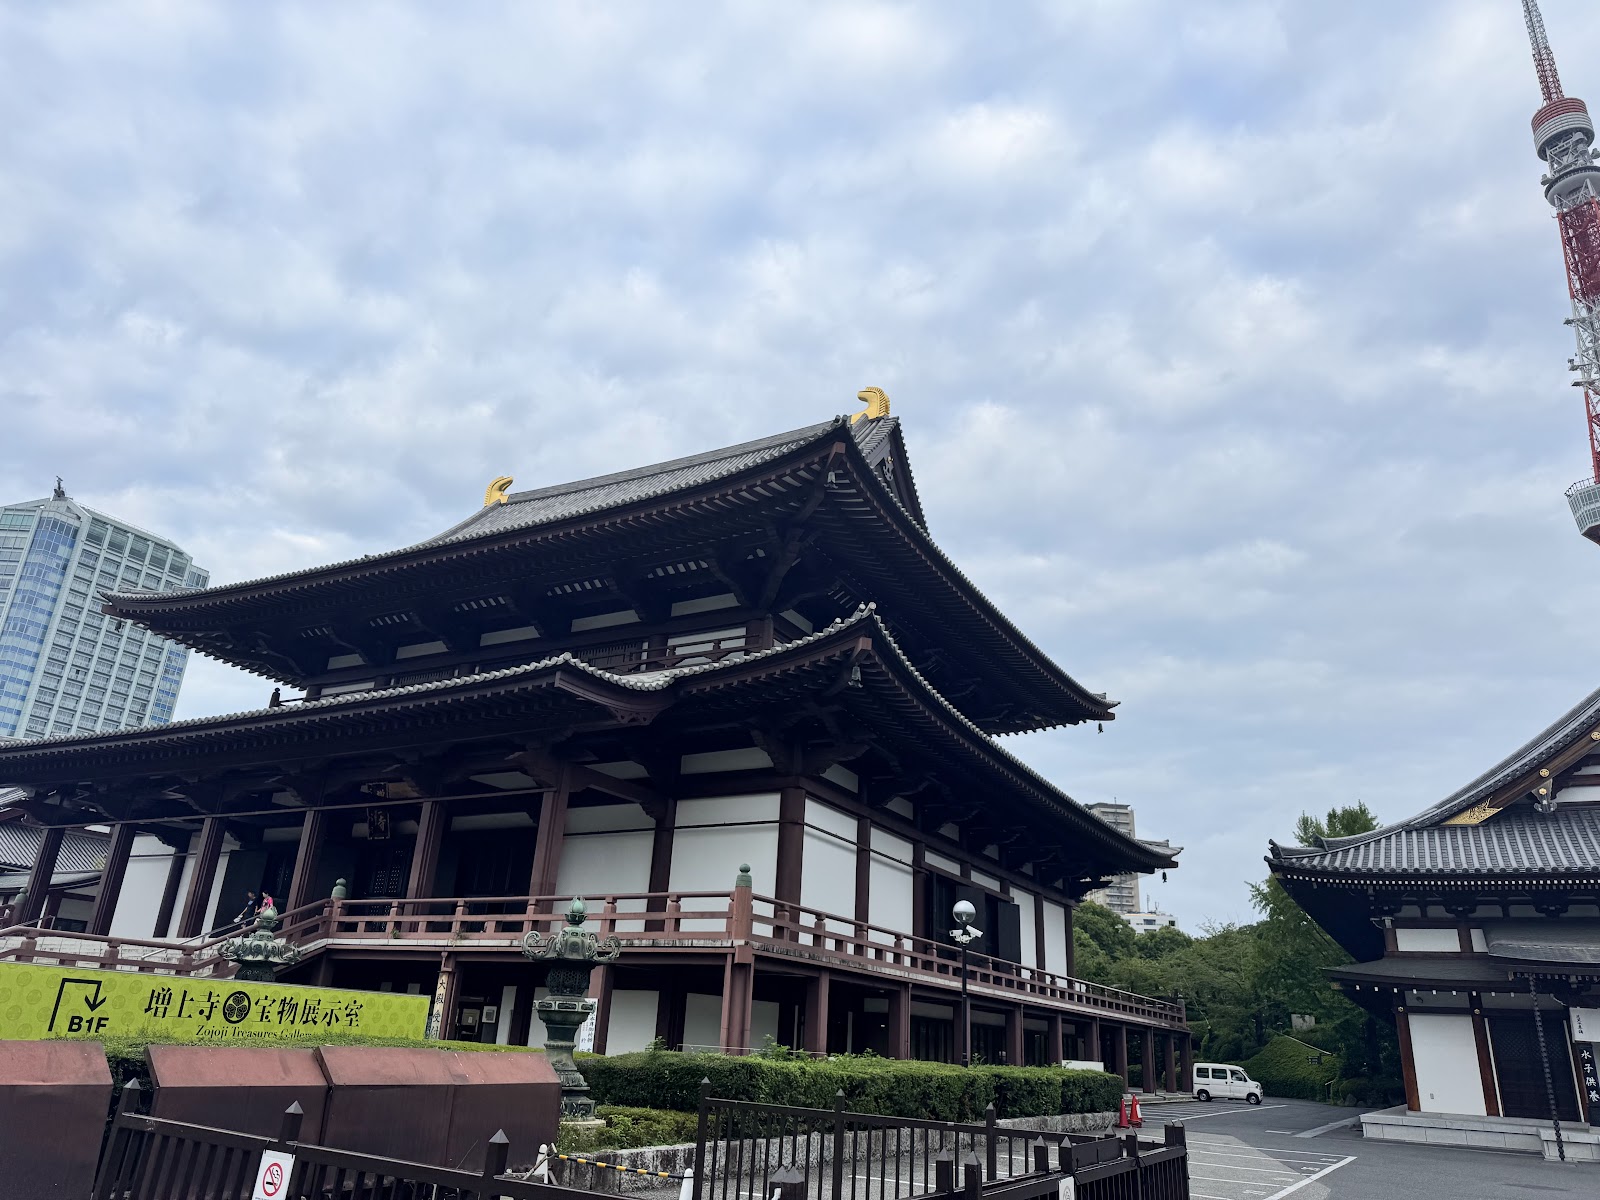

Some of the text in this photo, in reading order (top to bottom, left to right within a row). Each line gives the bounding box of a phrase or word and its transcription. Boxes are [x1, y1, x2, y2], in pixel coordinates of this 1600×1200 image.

[144, 987, 363, 1027] 増上寺 宝物展示室
[68, 1016, 109, 1033] B1F
[196, 1024, 228, 1039] Zojoji
[231, 1026, 278, 1039] Treasures
